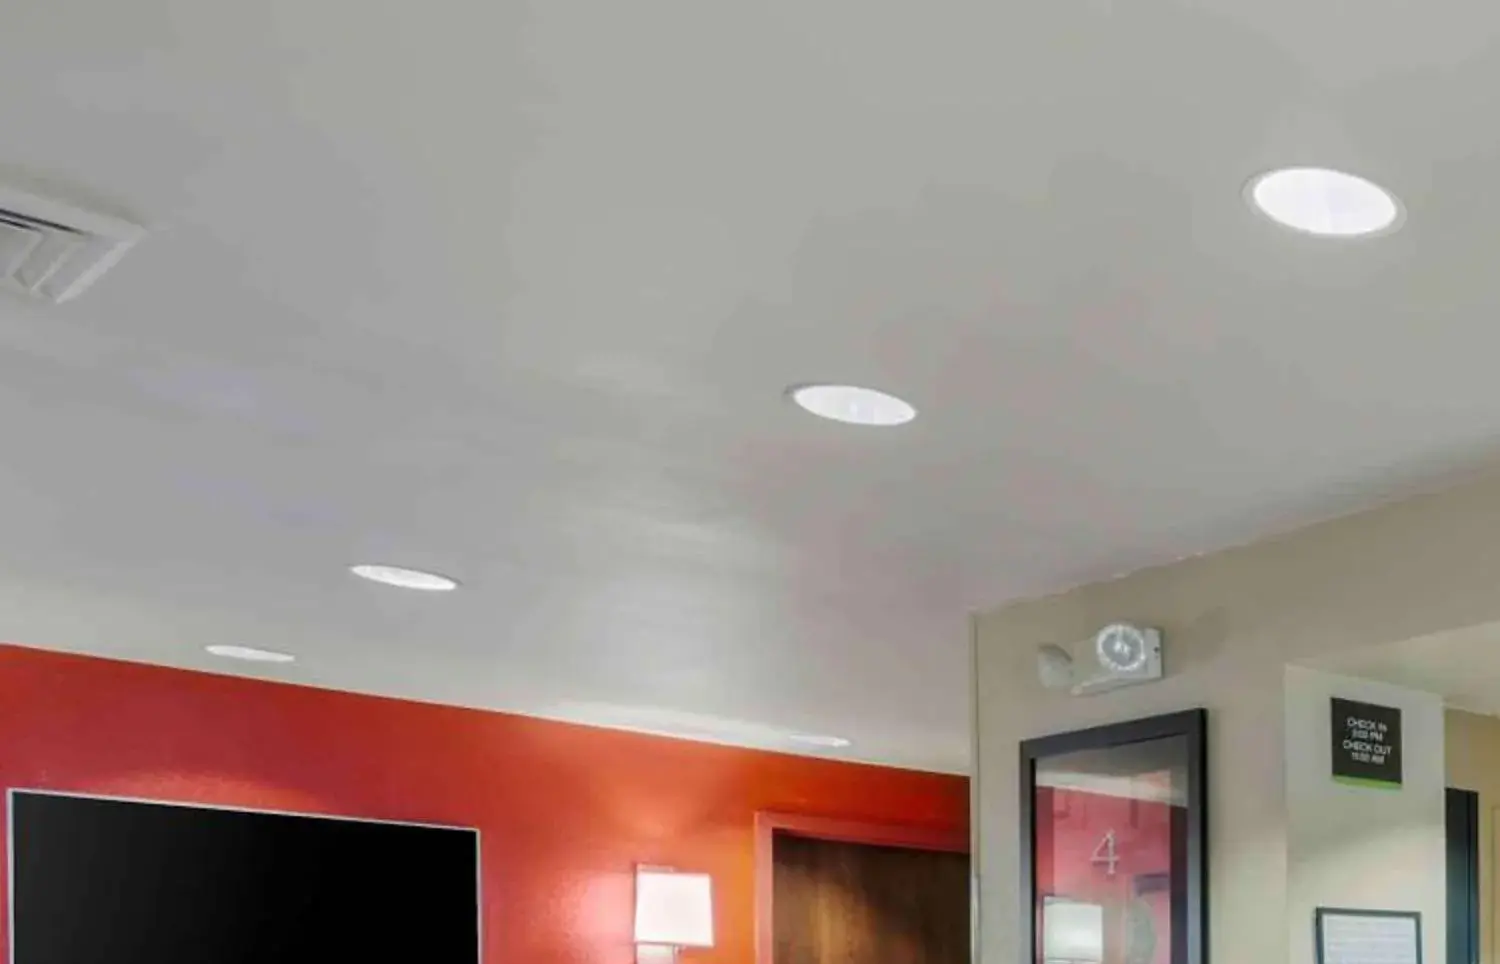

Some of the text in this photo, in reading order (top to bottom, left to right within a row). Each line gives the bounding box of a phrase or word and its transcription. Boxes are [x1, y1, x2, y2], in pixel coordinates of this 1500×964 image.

[1346, 717, 1376, 730] CHECK
[1342, 740, 1392, 756] CHECK OUT
[1089, 829, 1120, 875] 4
